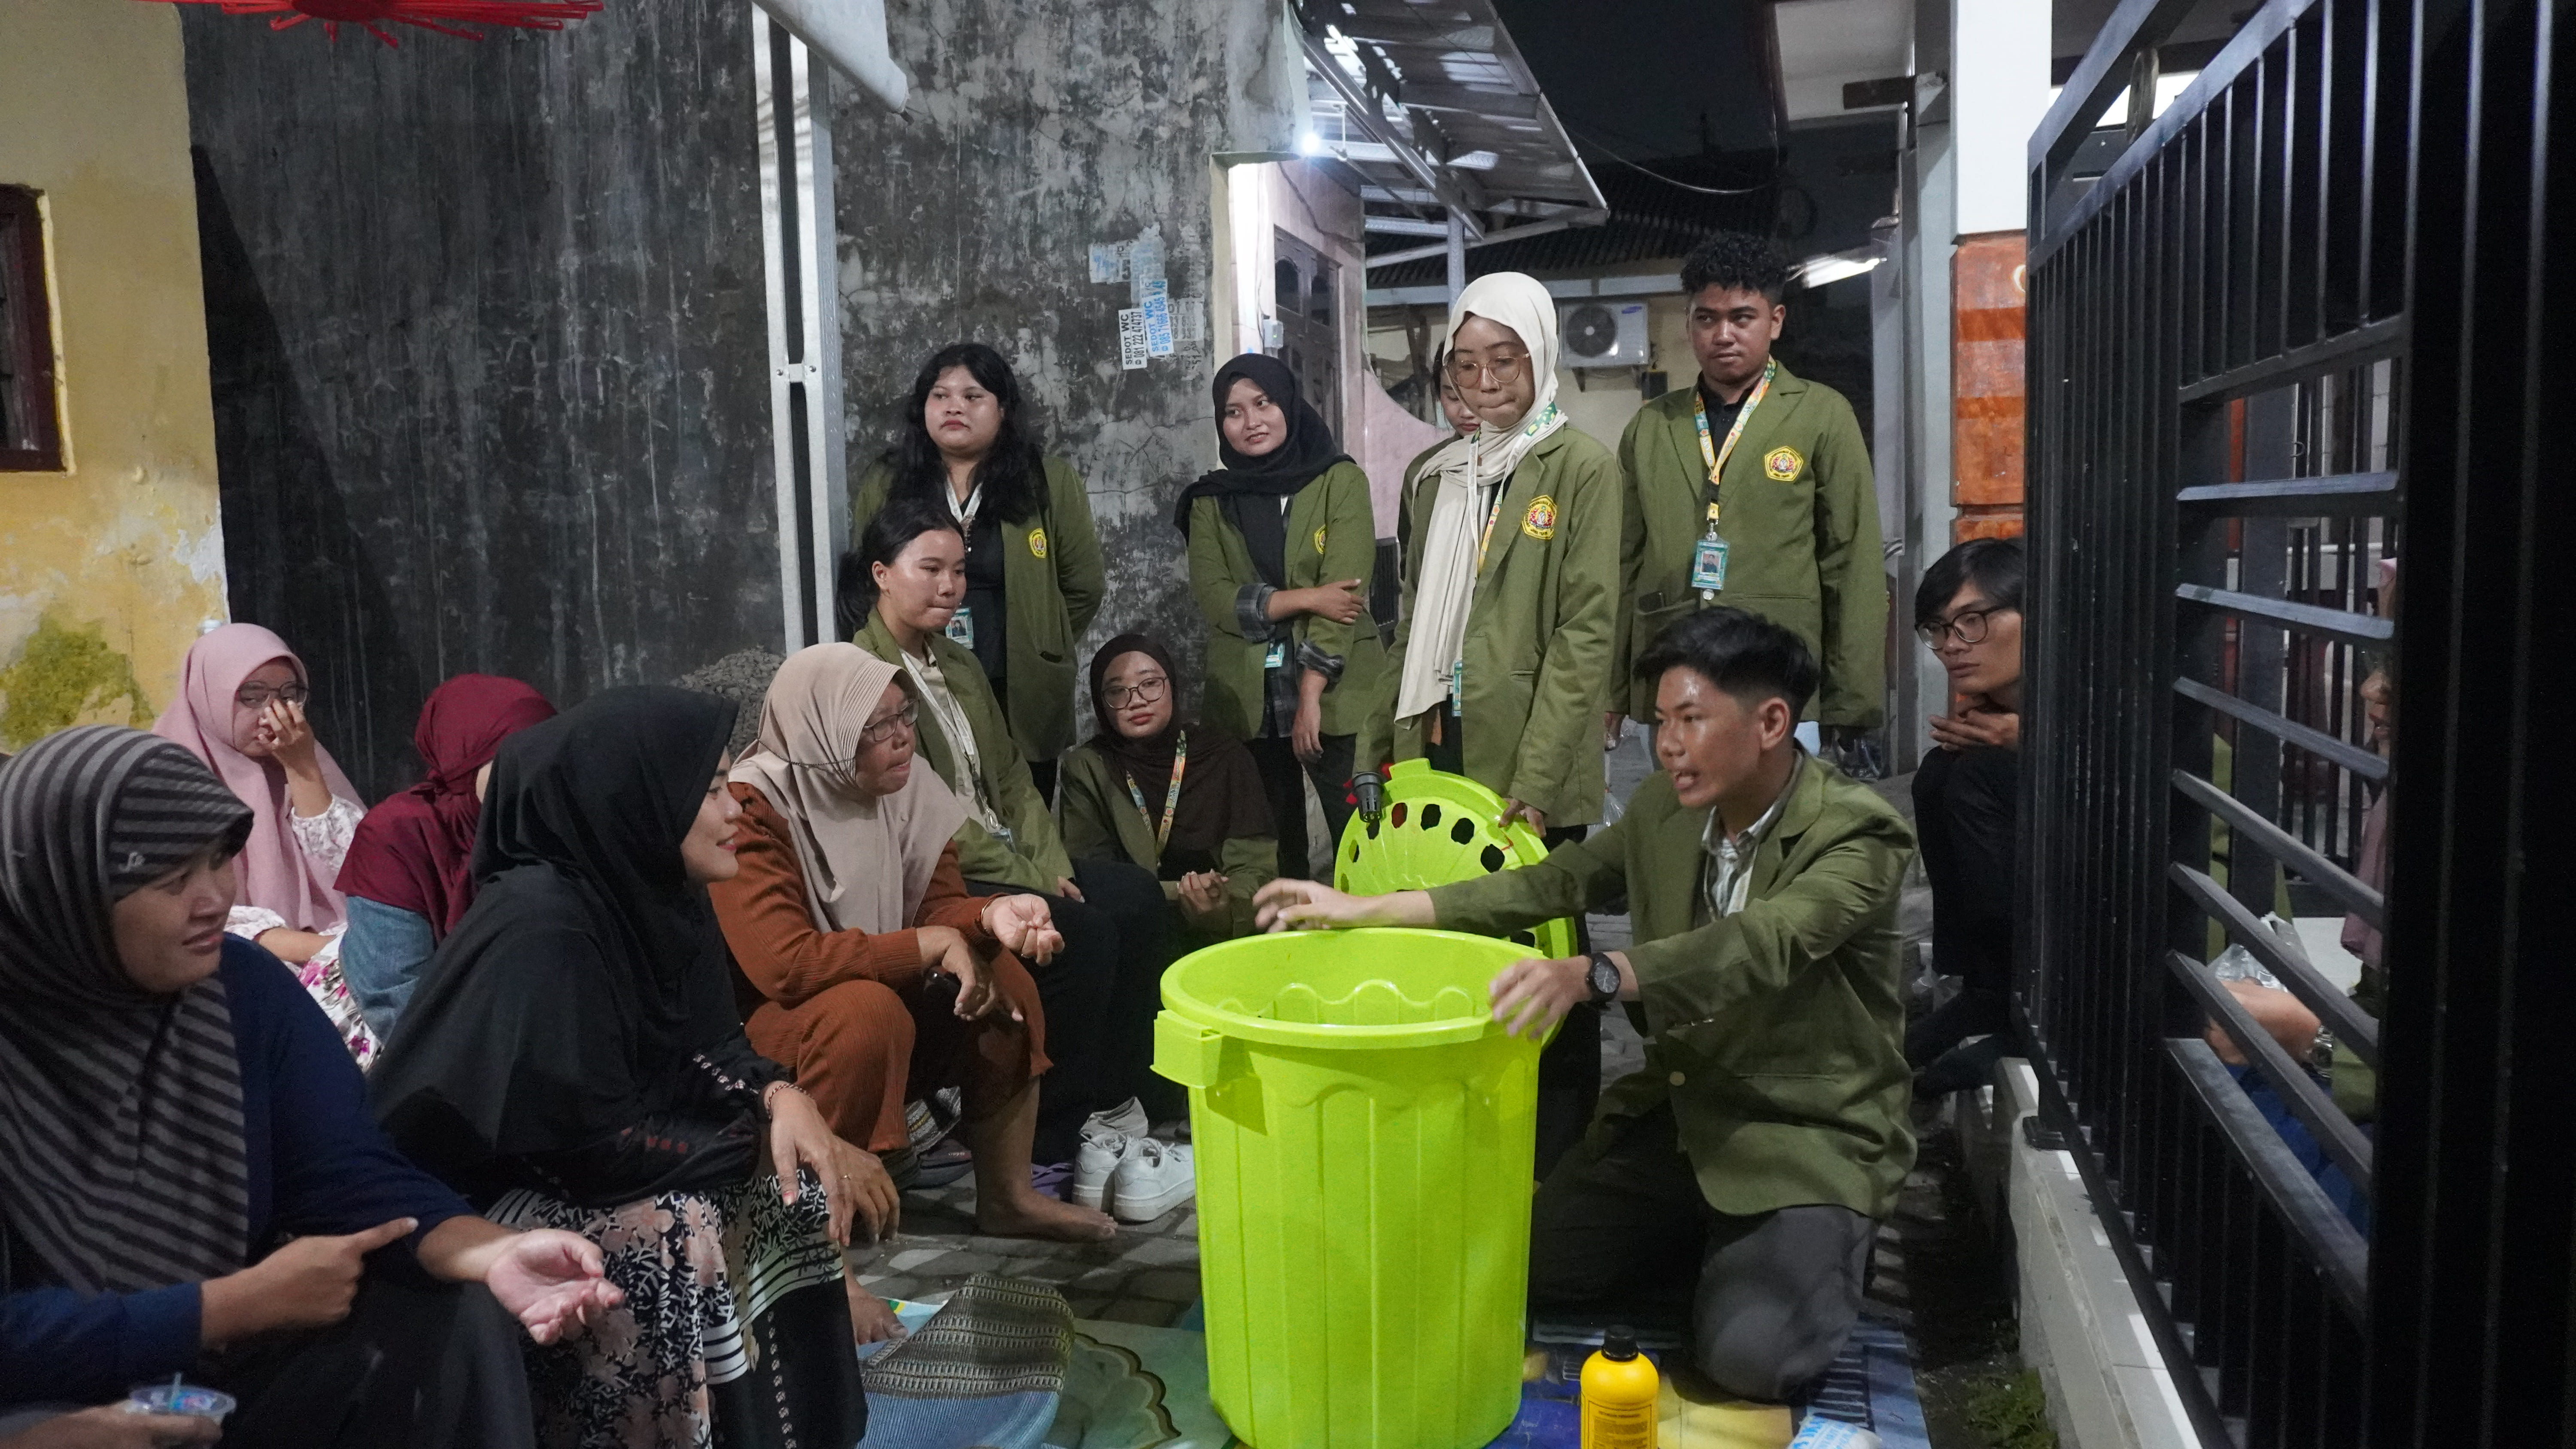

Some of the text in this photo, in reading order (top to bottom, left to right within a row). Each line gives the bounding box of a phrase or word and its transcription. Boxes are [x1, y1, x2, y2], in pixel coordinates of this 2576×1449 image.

[1143, 301, 1154, 320] WC
[1121, 314, 1132, 365] SEDOT WC
[1130, 312, 1145, 358] 081 222 474737
[1148, 323, 1158, 352] SEDOT
[1159, 332, 1171, 344] 085
